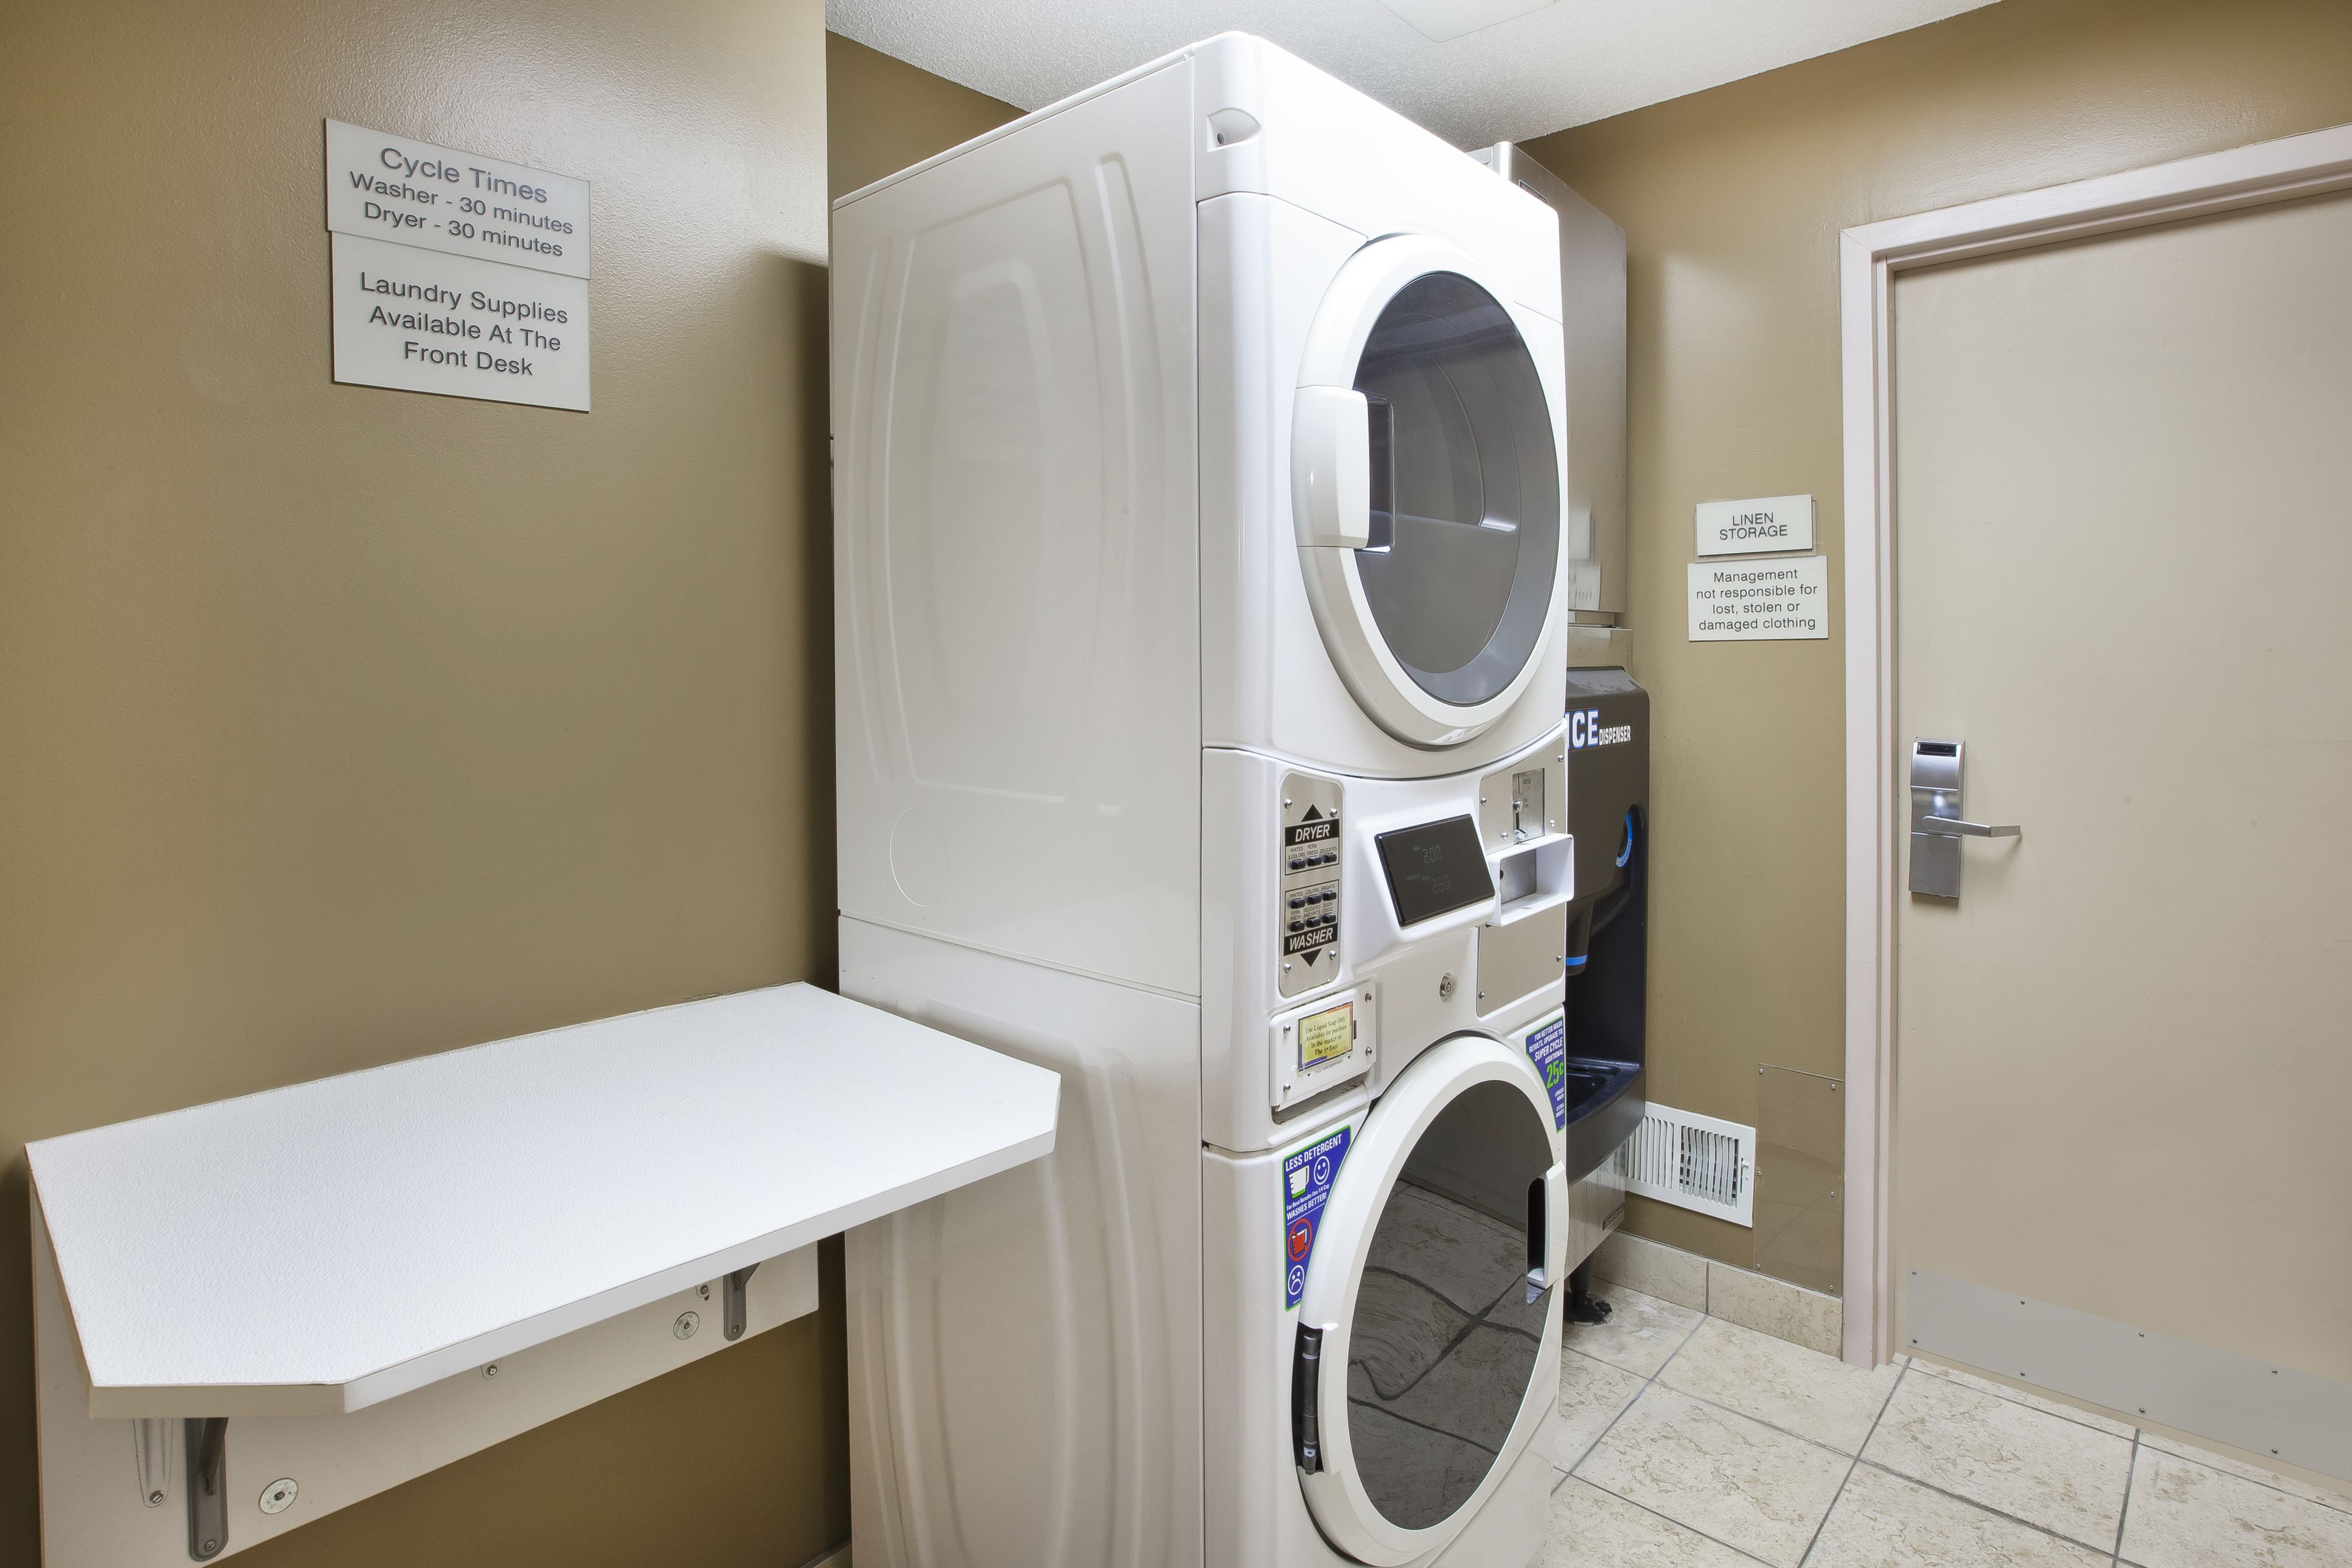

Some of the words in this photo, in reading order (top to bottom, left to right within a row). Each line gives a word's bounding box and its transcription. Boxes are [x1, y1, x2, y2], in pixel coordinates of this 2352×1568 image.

[381, 148, 460, 183] Cycle
[469, 167, 548, 203] Times
[350, 172, 439, 205] Washer
[460, 197, 486, 216] 30
[494, 205, 573, 234] minutes
[365, 202, 427, 229] Dryer
[449, 221, 475, 239] 30
[483, 229, 563, 257] minutes
[361, 272, 462, 310] Laundry
[471, 291, 568, 323] Supplies
[370, 305, 481, 339] Available
[490, 325, 513, 344] At
[520, 328, 562, 351] The
[404, 341, 468, 367] Front
[477, 352, 533, 376] Desk
[1733, 513, 1773, 526] LINEN
[1719, 525, 1788, 540] STORAGE
[1714, 569, 1798, 584] Management
[1697, 589, 1716, 599] not
[1721, 585, 1795, 600] responsible
[1800, 584, 1817, 595] for
[1713, 604, 1738, 615] lost,
[1743, 602, 1782, 613] stolen
[1787, 602, 1800, 611] or
[1699, 619, 1758, 631] damaged
[1763, 617, 1815, 630] clothing
[1599, 725, 1630, 745] DISPENSER
[1295, 824, 1330, 842] DRYER
[1290, 927, 1333, 951] WASHER
[1306, 1032, 1325, 1042] Available
[1332, 1025, 1347, 1035] purchase
[1314, 1022, 1327, 1031] Liquid
[1542, 1025, 1553, 1037] BETTER
[1553, 1020, 1562, 1030] WASH
[1544, 1030, 1558, 1044] UPGRADE
[1535, 1045, 1550, 1061] SUPER
[1550, 1037, 1563, 1052] CYCLE
[1545, 1049, 1563, 1065] ADDITIONAL
[1286, 1154, 1303, 1172] LESS
[1304, 1134, 1342, 1163] DETERGENT
[1287, 1202, 1308, 1221] WASHES
[1308, 1191, 1327, 1208] BETTER!
[1300, 1193, 1312, 1204] Results
